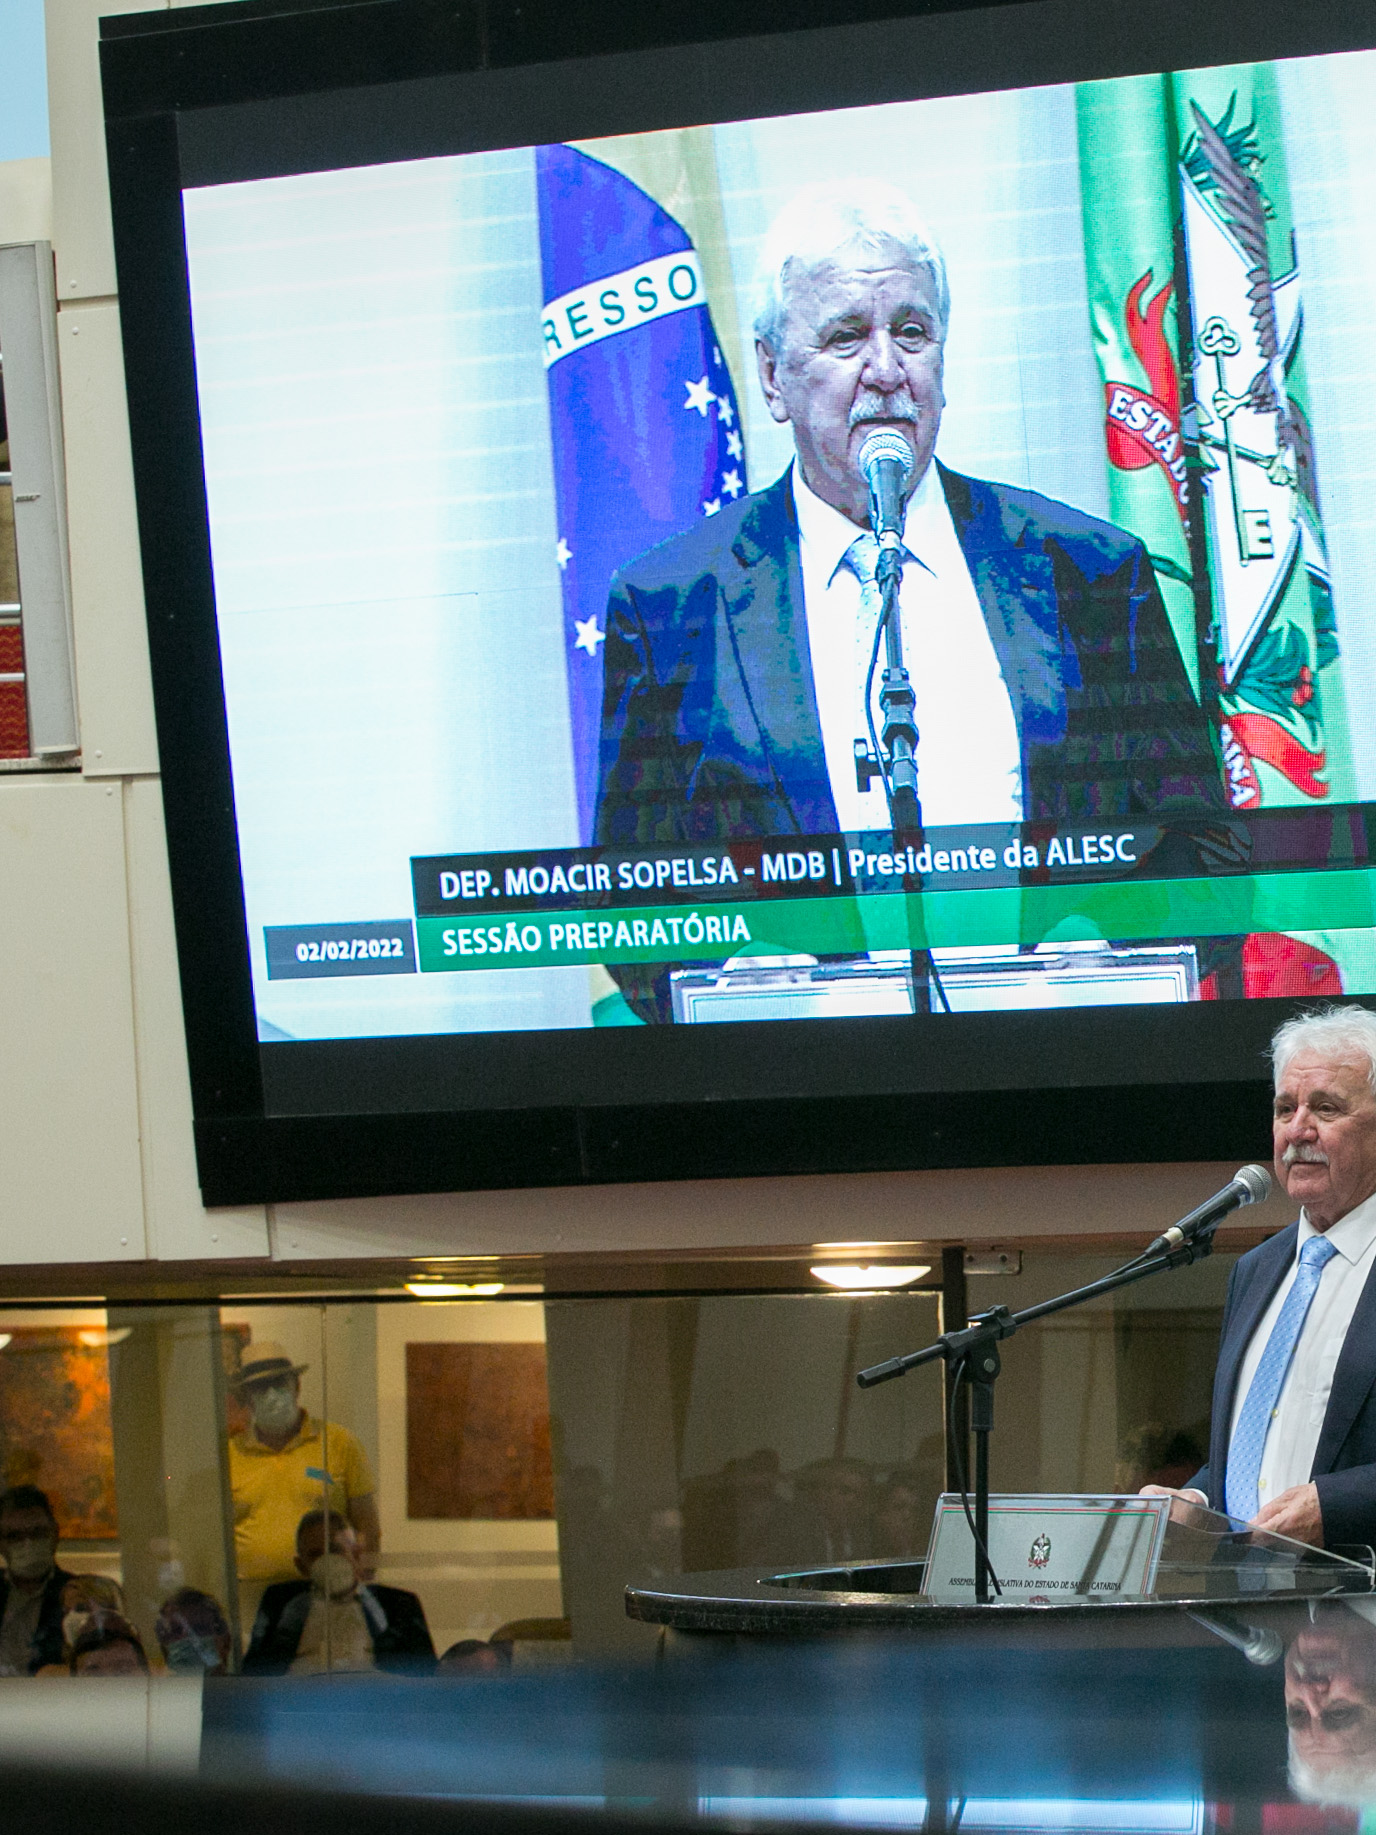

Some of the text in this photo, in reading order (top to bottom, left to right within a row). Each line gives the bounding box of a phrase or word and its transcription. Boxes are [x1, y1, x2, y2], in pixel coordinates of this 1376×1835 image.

[440, 868, 499, 899] DEP.
[505, 862, 612, 896] MOACIR
[618, 856, 738, 889] SOPELSA
[762, 853, 826, 882] MDB
[848, 842, 997, 877] Presidente
[1003, 839, 1039, 867] da
[1046, 834, 1136, 865] ALESC
[296, 937, 404, 963] 02/02/2022
[442, 914, 751, 956] SESSÃO PREPARATÓRIA
